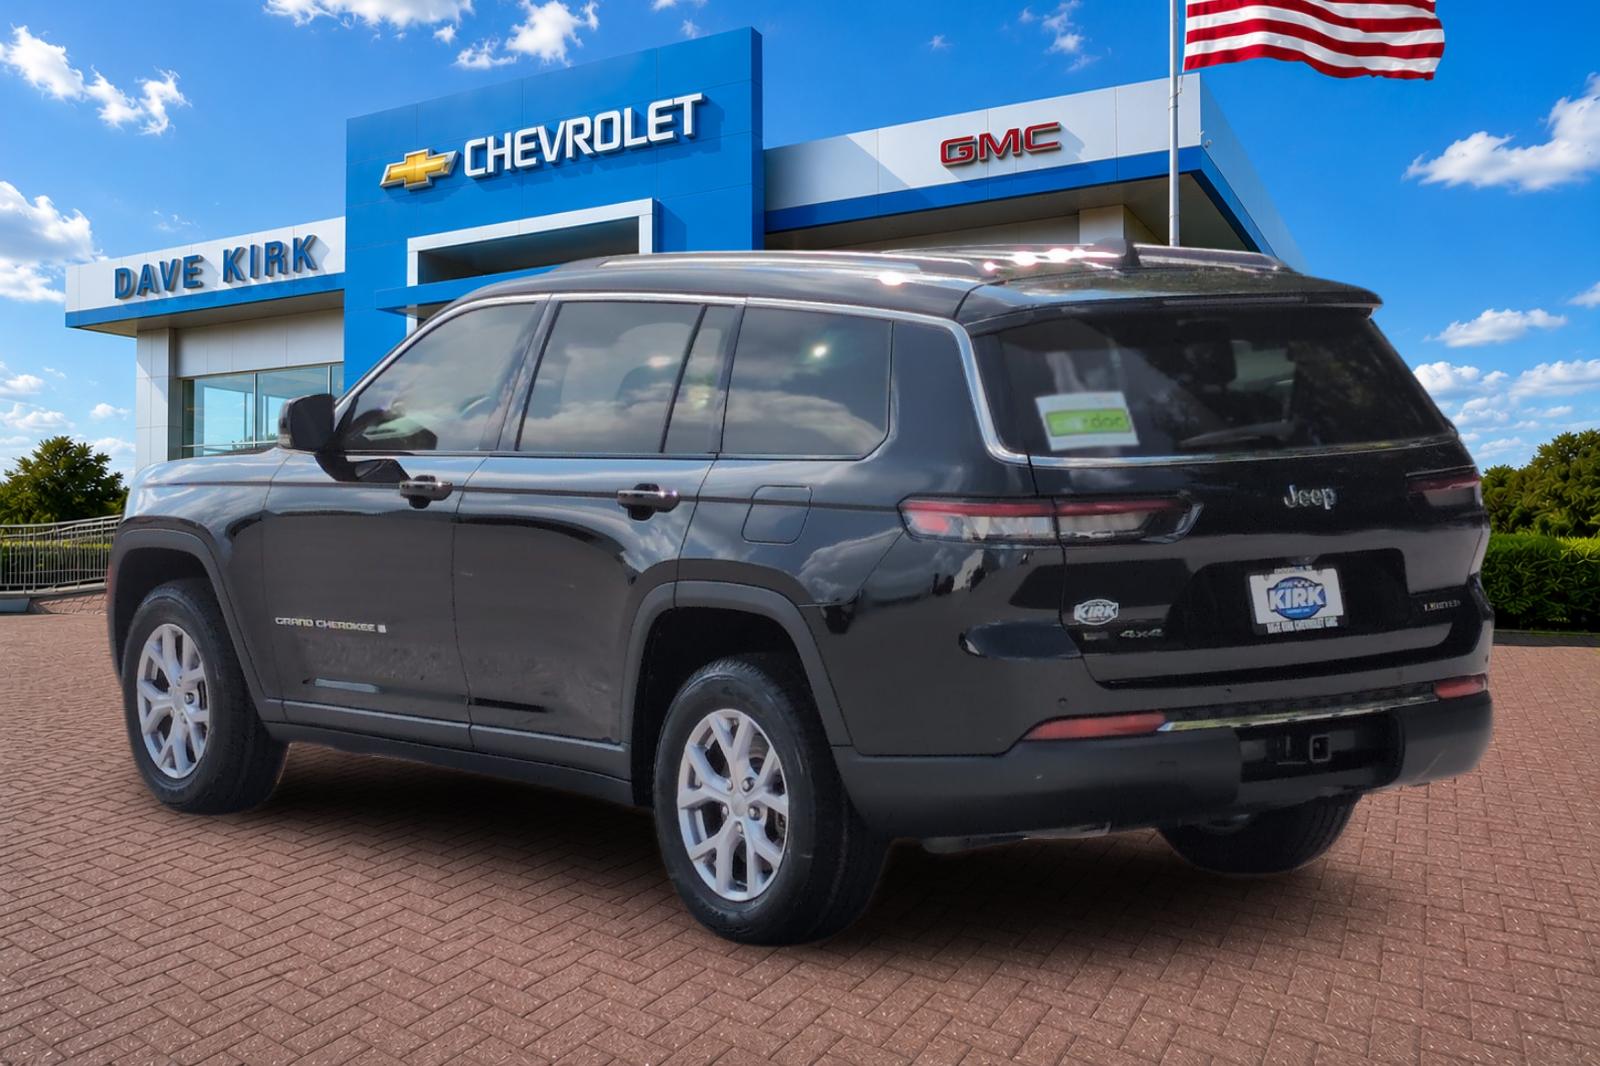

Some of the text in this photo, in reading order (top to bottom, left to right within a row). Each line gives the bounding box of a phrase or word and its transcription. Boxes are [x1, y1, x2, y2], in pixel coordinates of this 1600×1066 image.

[463, 92, 704, 178] CHEVROLET
[940, 121, 1061, 166] GMC
[114, 234, 318, 300] DAVE KIRK
[1283, 484, 1337, 510] Jeep
[1268, 585, 1326, 610] KIRK
[275, 617, 314, 627] GRAND
[315, 619, 376, 632] CHEROKEE
[1076, 604, 1116, 619] KIRK
